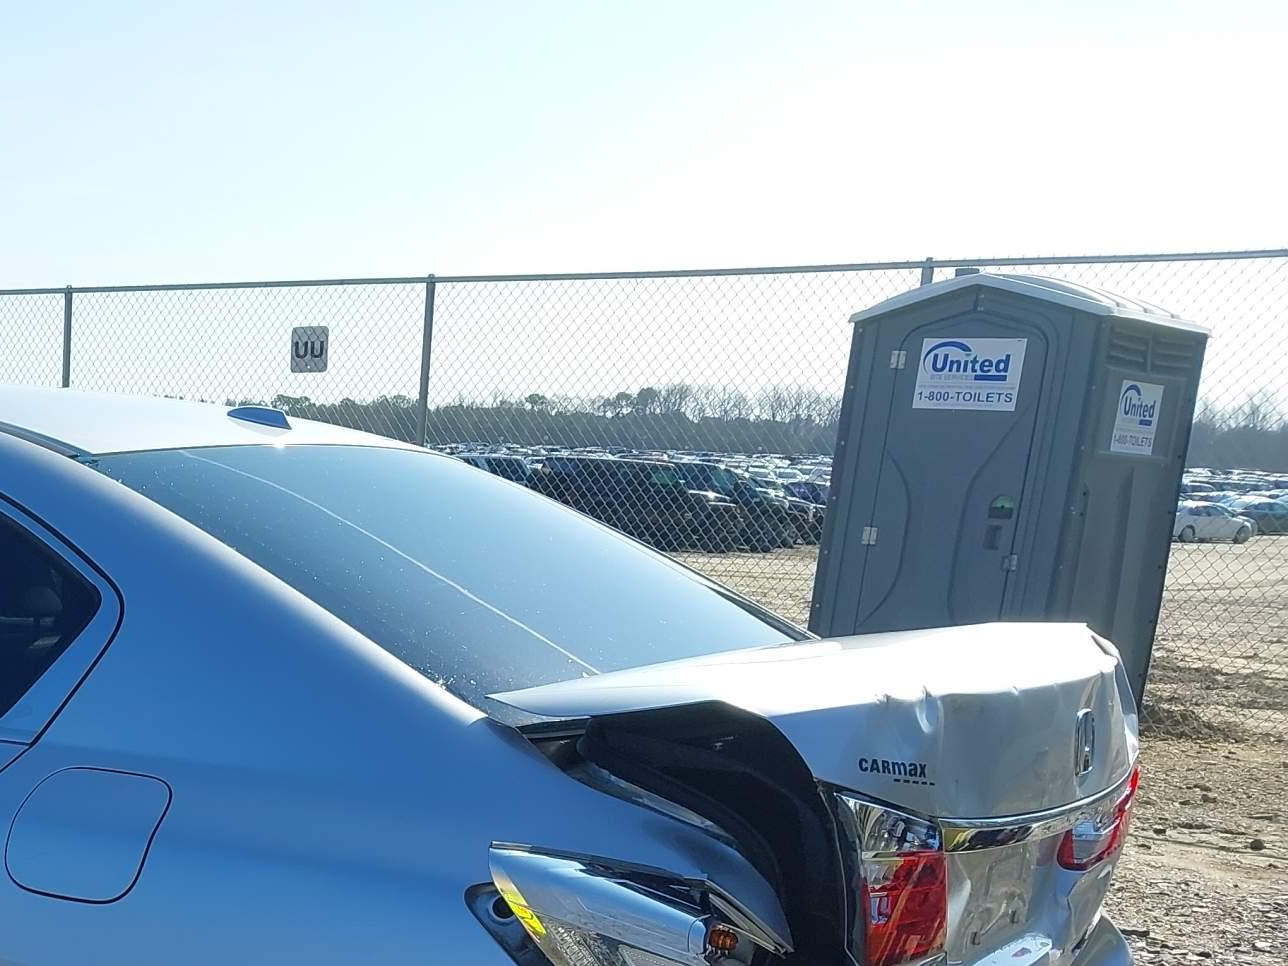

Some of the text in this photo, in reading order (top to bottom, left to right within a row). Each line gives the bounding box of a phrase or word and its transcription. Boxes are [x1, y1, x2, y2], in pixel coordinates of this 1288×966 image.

[294, 340, 325, 359] UU
[931, 352, 1011, 373] United
[917, 391, 1014, 403] 1-800-TOILETS
[1123, 396, 1157, 418] United
